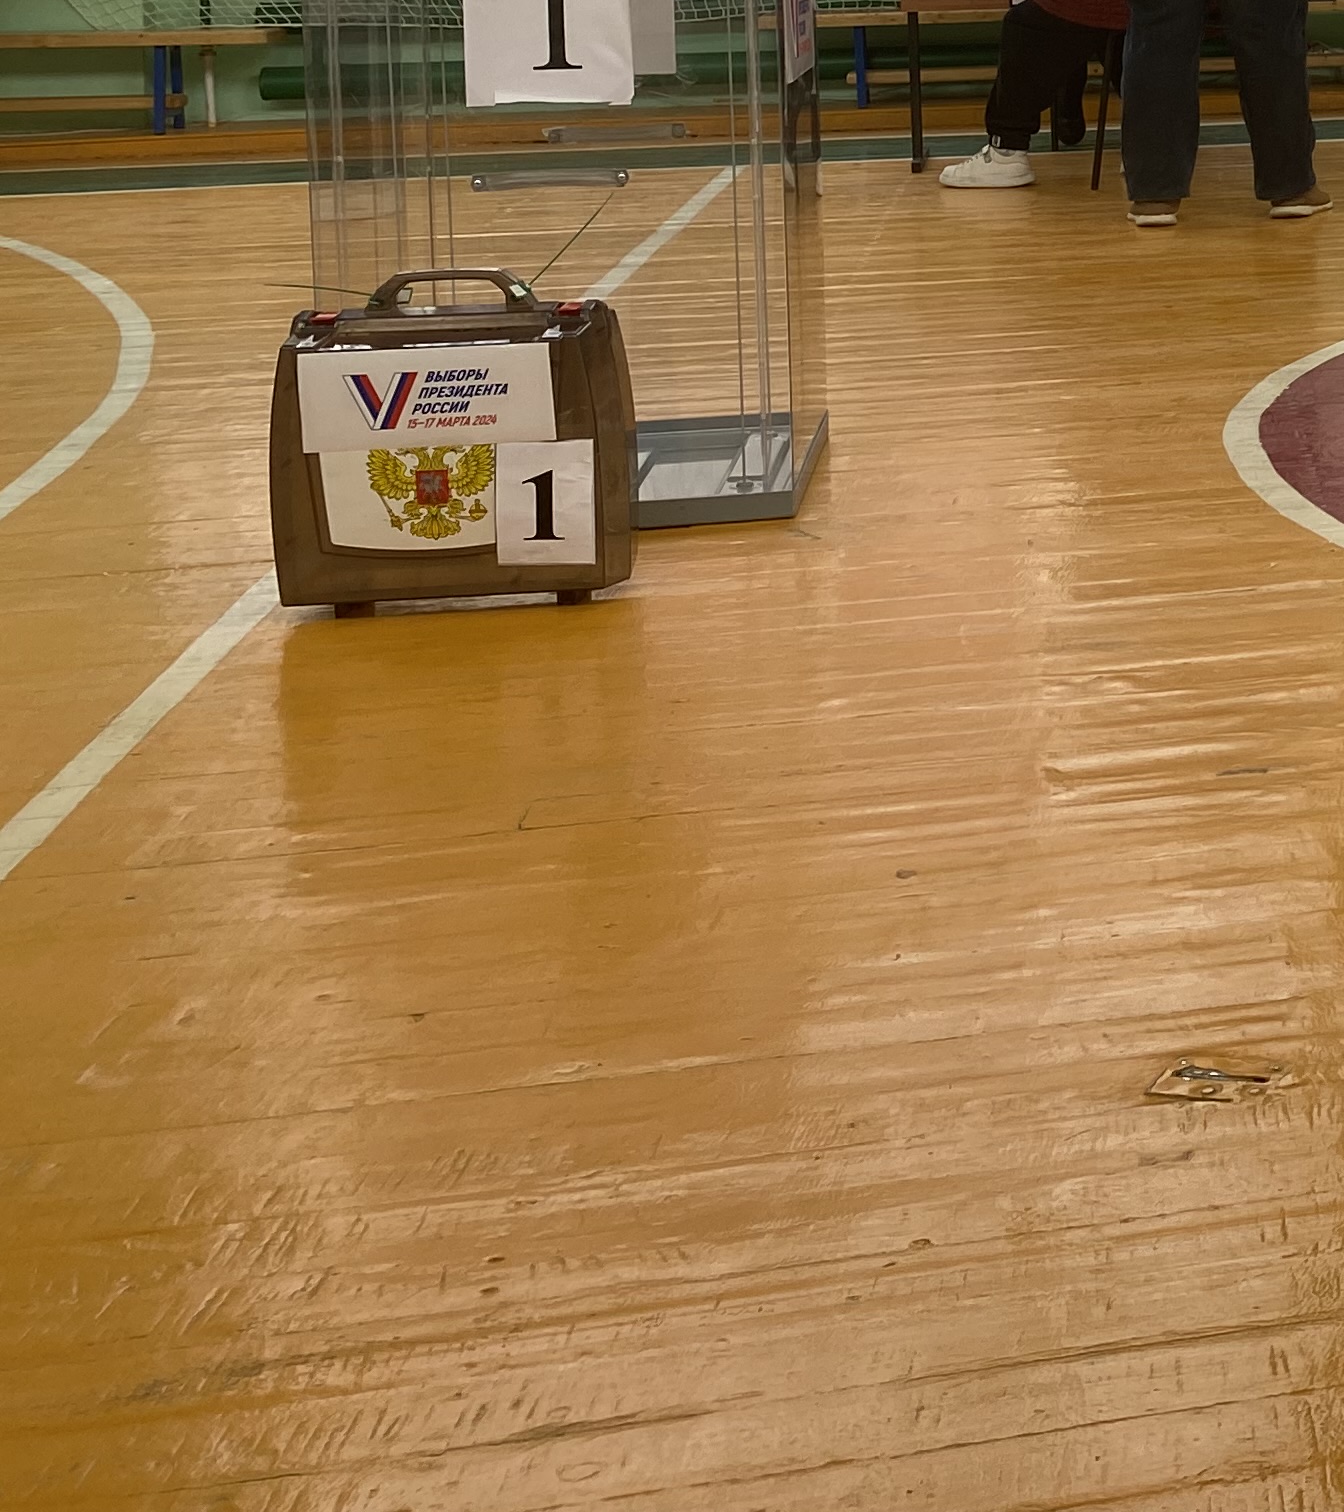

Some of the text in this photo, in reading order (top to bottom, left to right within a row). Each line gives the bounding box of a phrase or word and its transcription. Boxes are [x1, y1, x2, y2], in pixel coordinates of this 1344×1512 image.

[425, 368, 489, 383] ВЫБОРЫ
[418, 383, 508, 399] ПРЕЗИДЕНТА
[412, 400, 470, 415] РОССИИ
[436, 415, 471, 427] МАРТА
[472, 414, 497, 426] 2024
[522, 469, 565, 540] 1
